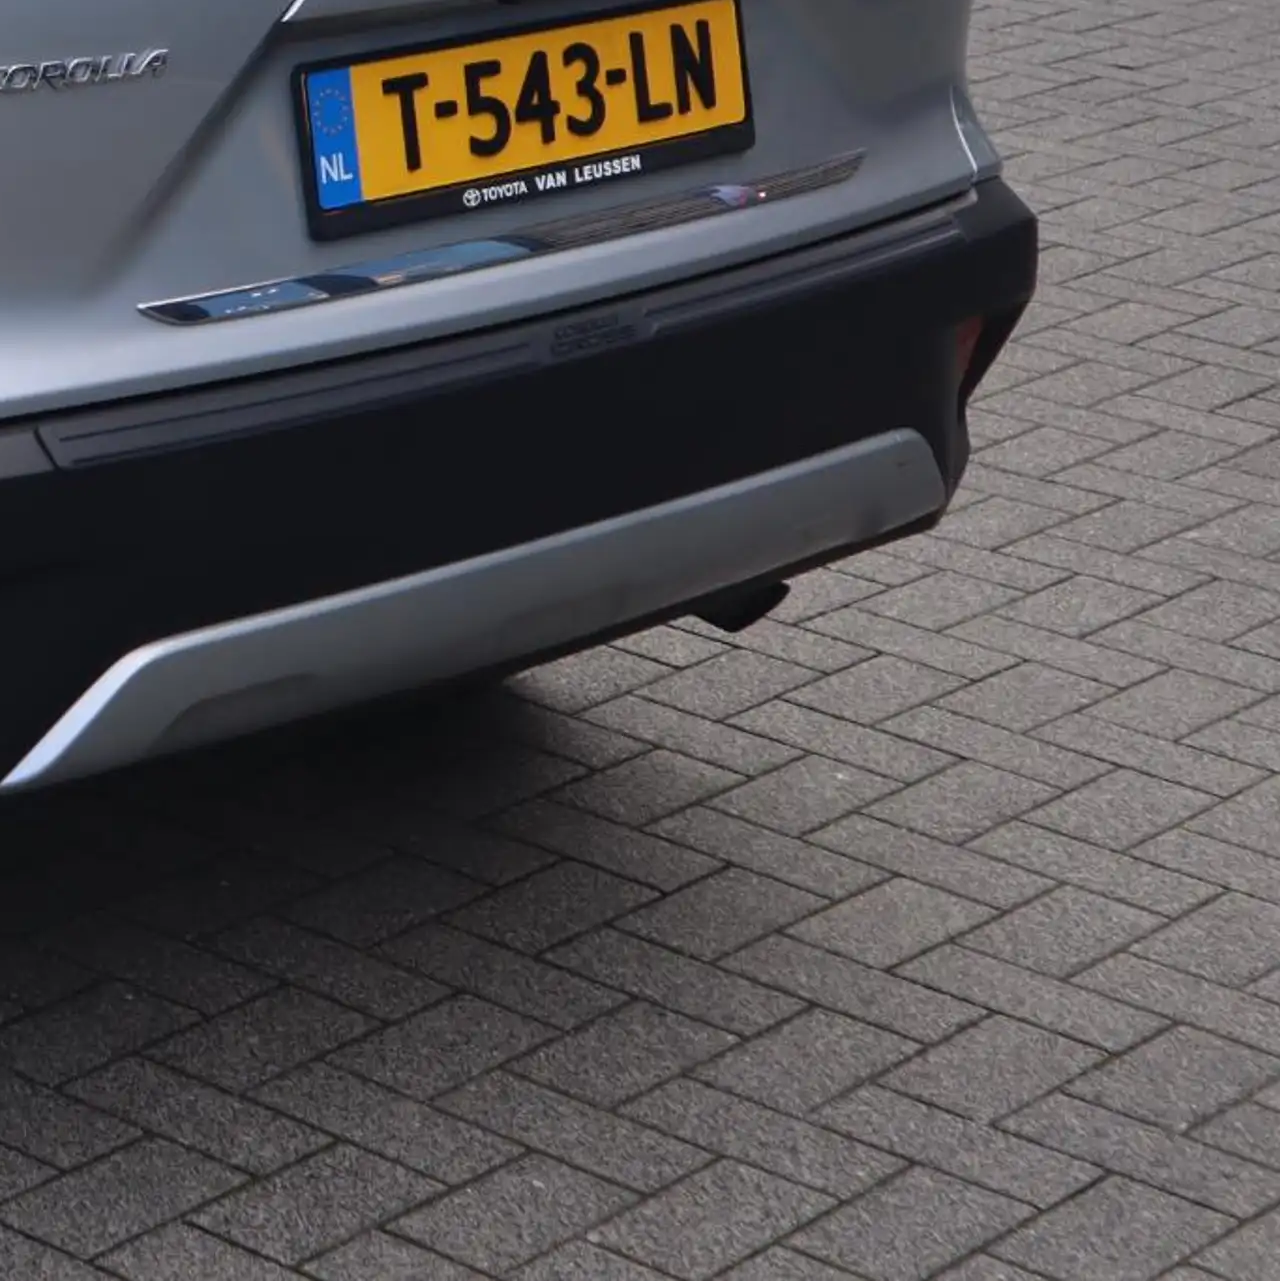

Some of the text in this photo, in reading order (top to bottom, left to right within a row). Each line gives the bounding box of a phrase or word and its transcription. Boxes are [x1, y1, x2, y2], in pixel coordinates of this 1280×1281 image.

[381, 19, 717, 172] T-543-LN
[319, 152, 354, 185] NL
[482, 154, 642, 202] TOYOTA VAN LEUSSEN
